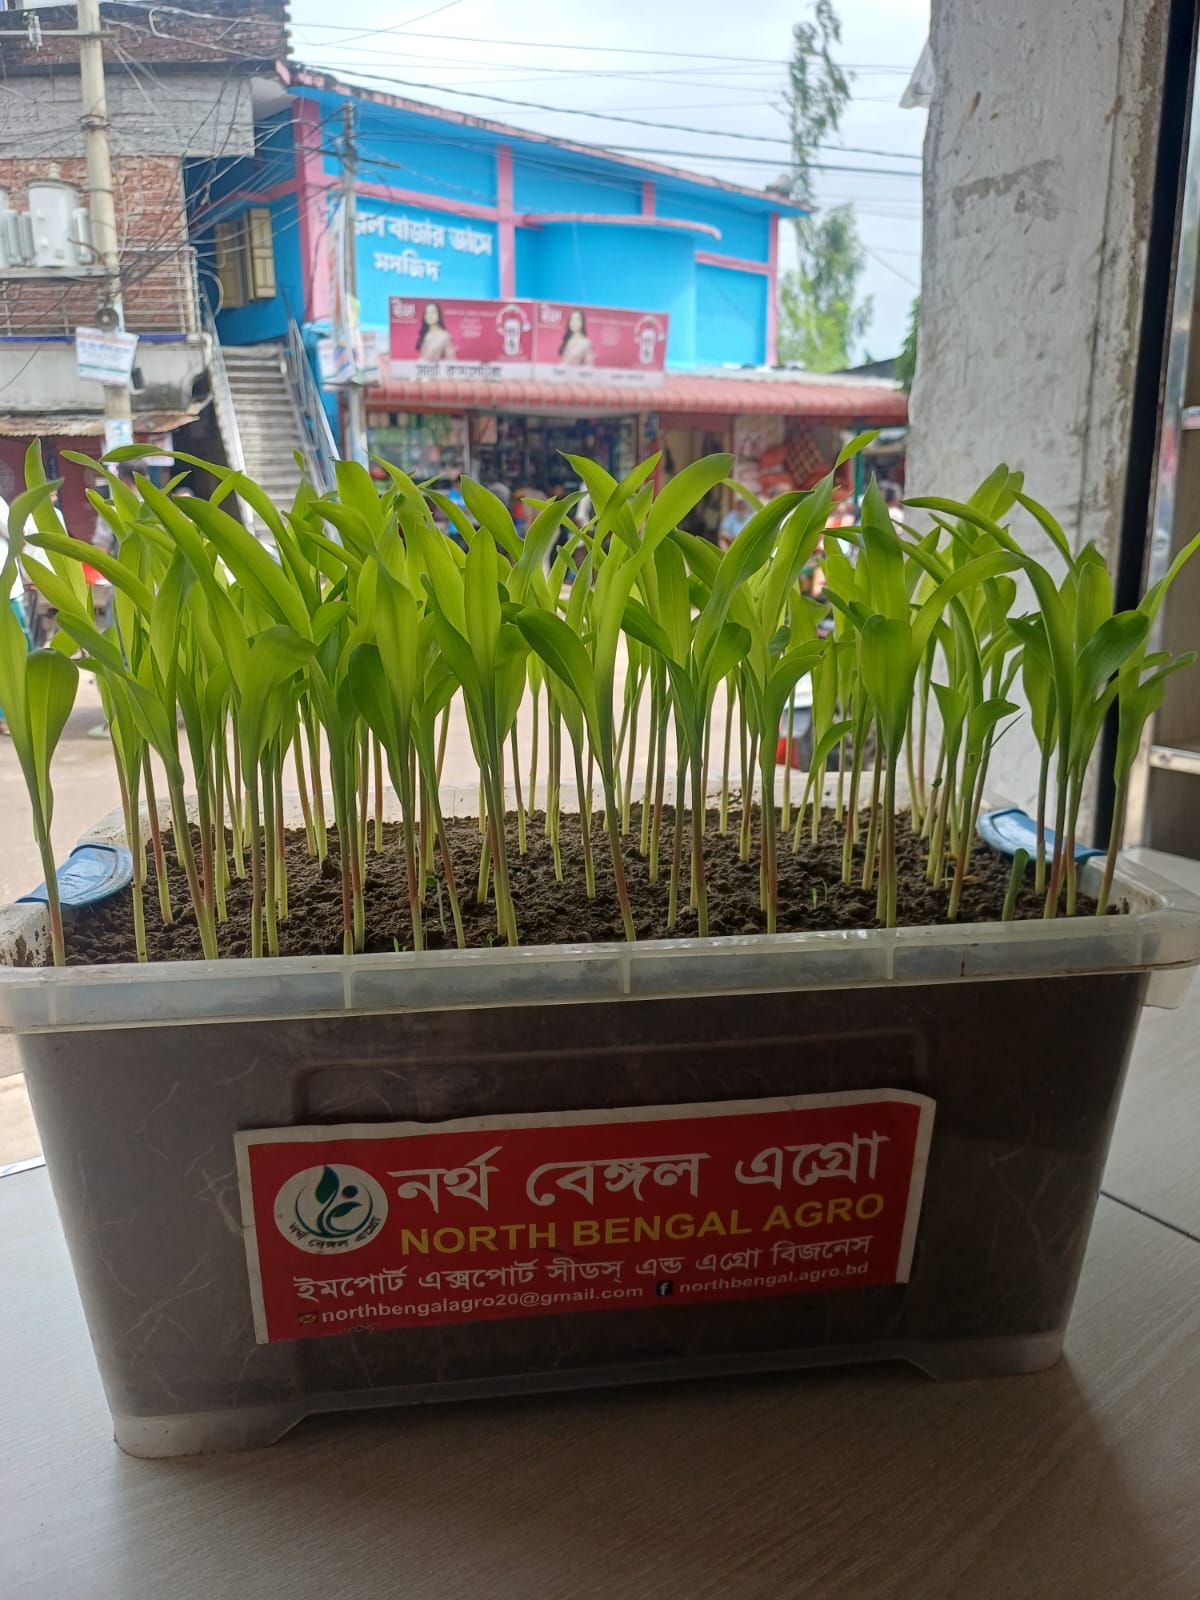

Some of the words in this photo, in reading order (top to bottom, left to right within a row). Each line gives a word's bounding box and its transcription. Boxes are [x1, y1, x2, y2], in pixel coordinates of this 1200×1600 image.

[373, 249, 442, 281] মসজিদ
[386, 1146, 503, 1214] নর্থ
[526, 1152, 712, 1207] বেঙ্গল
[735, 1130, 890, 1190] এগ্রো
[401, 1221, 557, 1256] NORTH
[573, 1208, 752, 1247] BENGAL
[762, 1192, 885, 1232] AGRO
[292, 1265, 409, 1303] ইমপোর্ট
[418, 1258, 540, 1292] এক্সপোর্ট
[695, 1246, 764, 1273] এগ্রো
[770, 1234, 876, 1267] বিজনেস
[679, 1260, 870, 1294] northbengal.agro.bd
[321, 1285, 644, 1324] northbengalagro20@gmail.com
